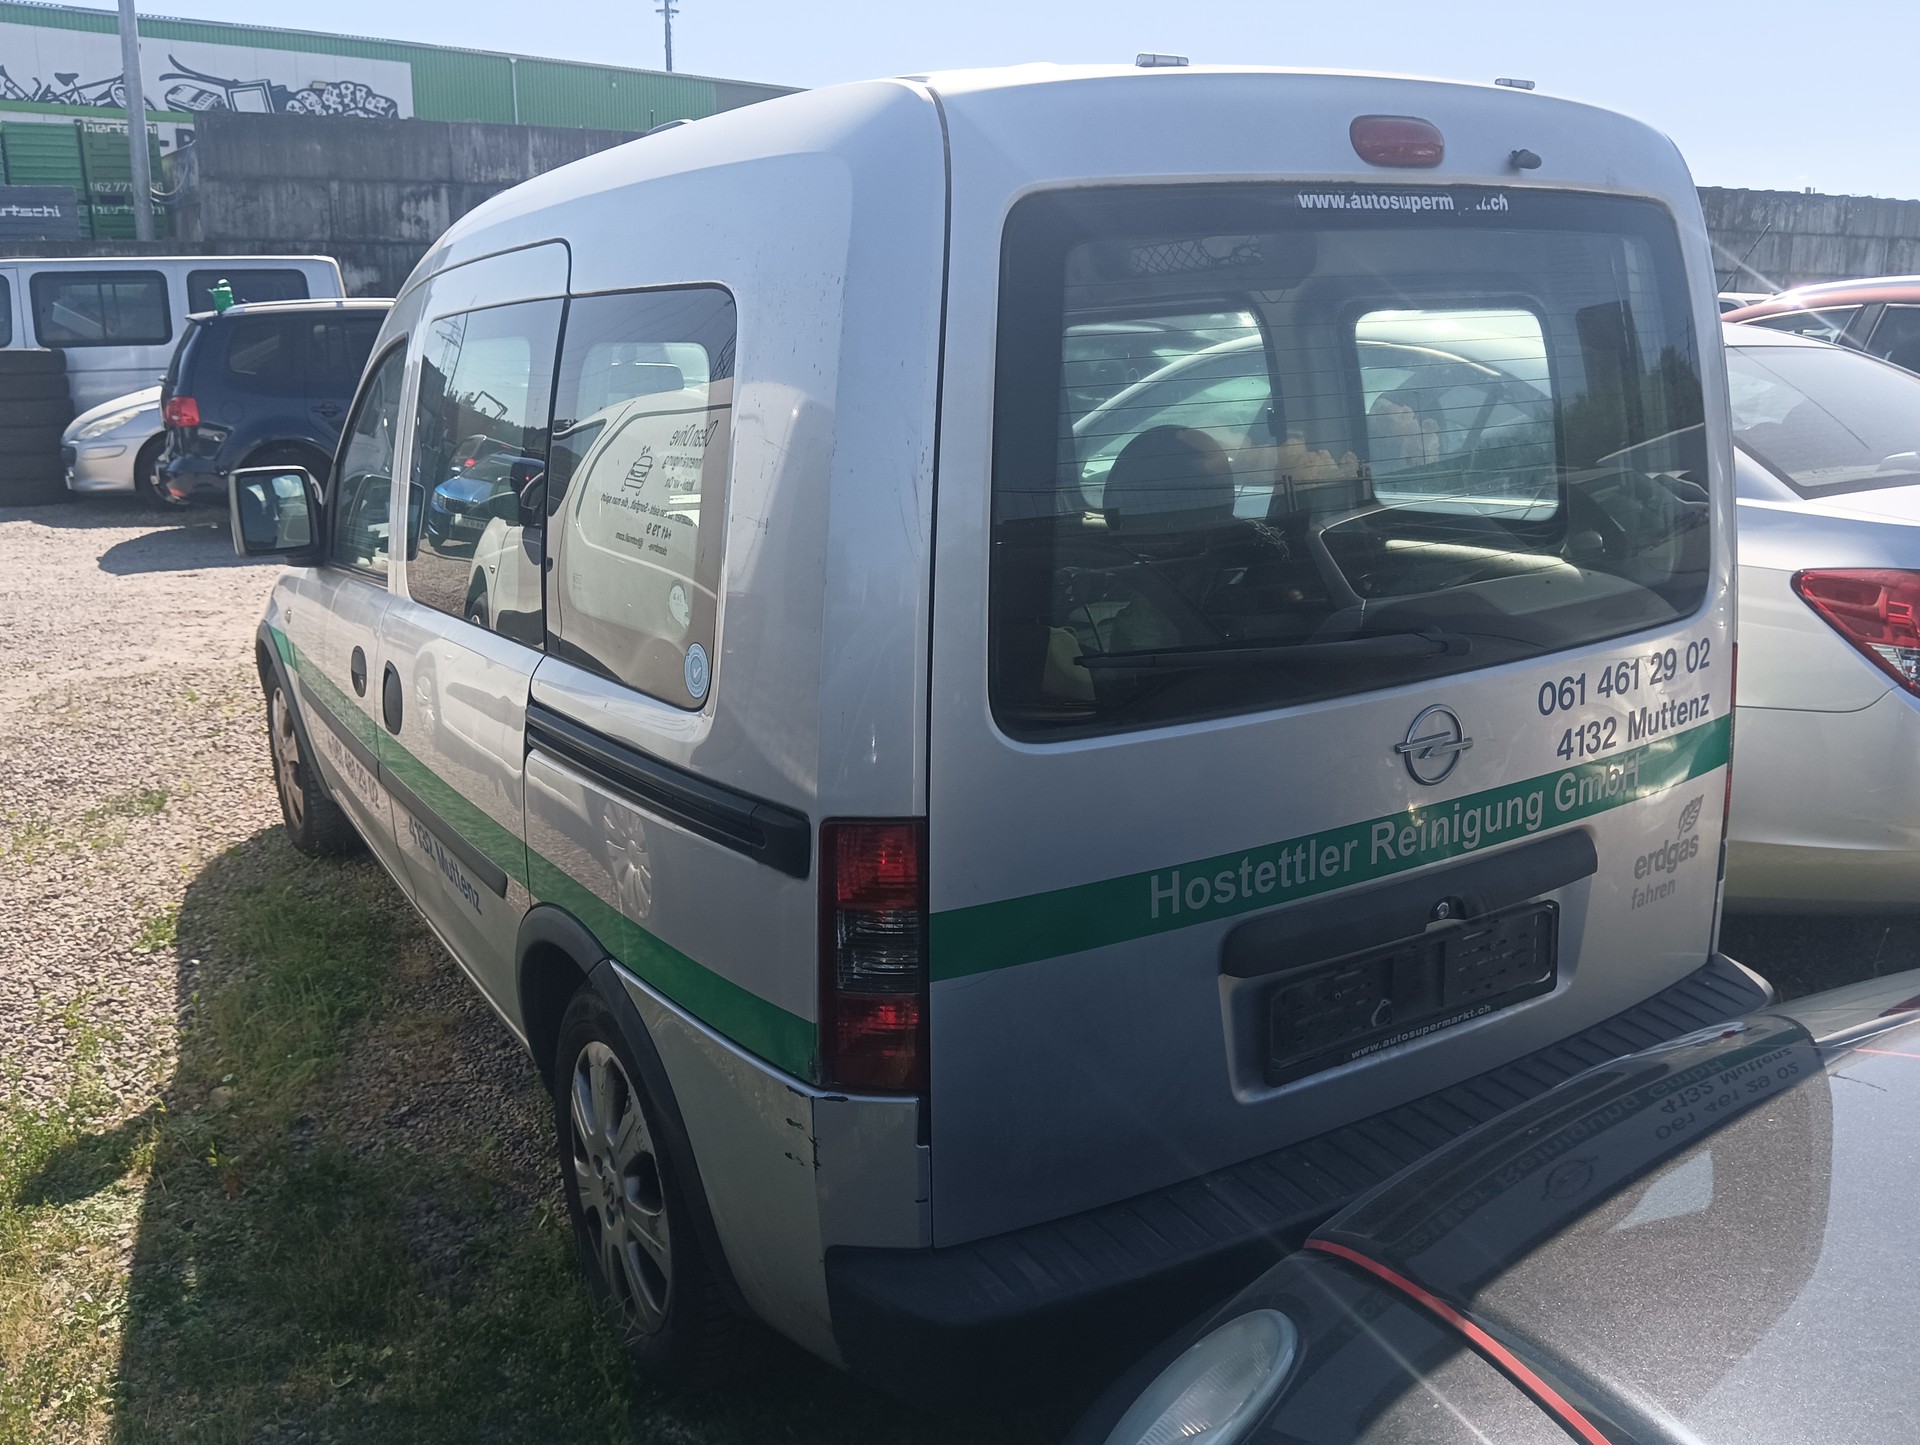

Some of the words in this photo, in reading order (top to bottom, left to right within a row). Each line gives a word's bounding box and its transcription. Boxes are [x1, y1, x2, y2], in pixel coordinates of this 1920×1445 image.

[0, 204, 61, 217] rtschi
[1538, 673, 1586, 716] 061
[1597, 658, 1640, 699] 461
[1650, 648, 1677, 686] 29
[1686, 637, 1710, 674] 02
[1557, 716, 1617, 761] 4132
[1627, 693, 1710, 743] Muttenz
[1150, 837, 1358, 919] Hostettler
[1371, 790, 1544, 865] Reinigung
[1554, 752, 1640, 812] GmbH
[1633, 834, 1699, 880] erdgas
[434, 840, 483, 916] Muttenz
[1631, 878, 1676, 910] fahren
[1351, 1004, 1492, 1059] www.autosupermarkt.ch
